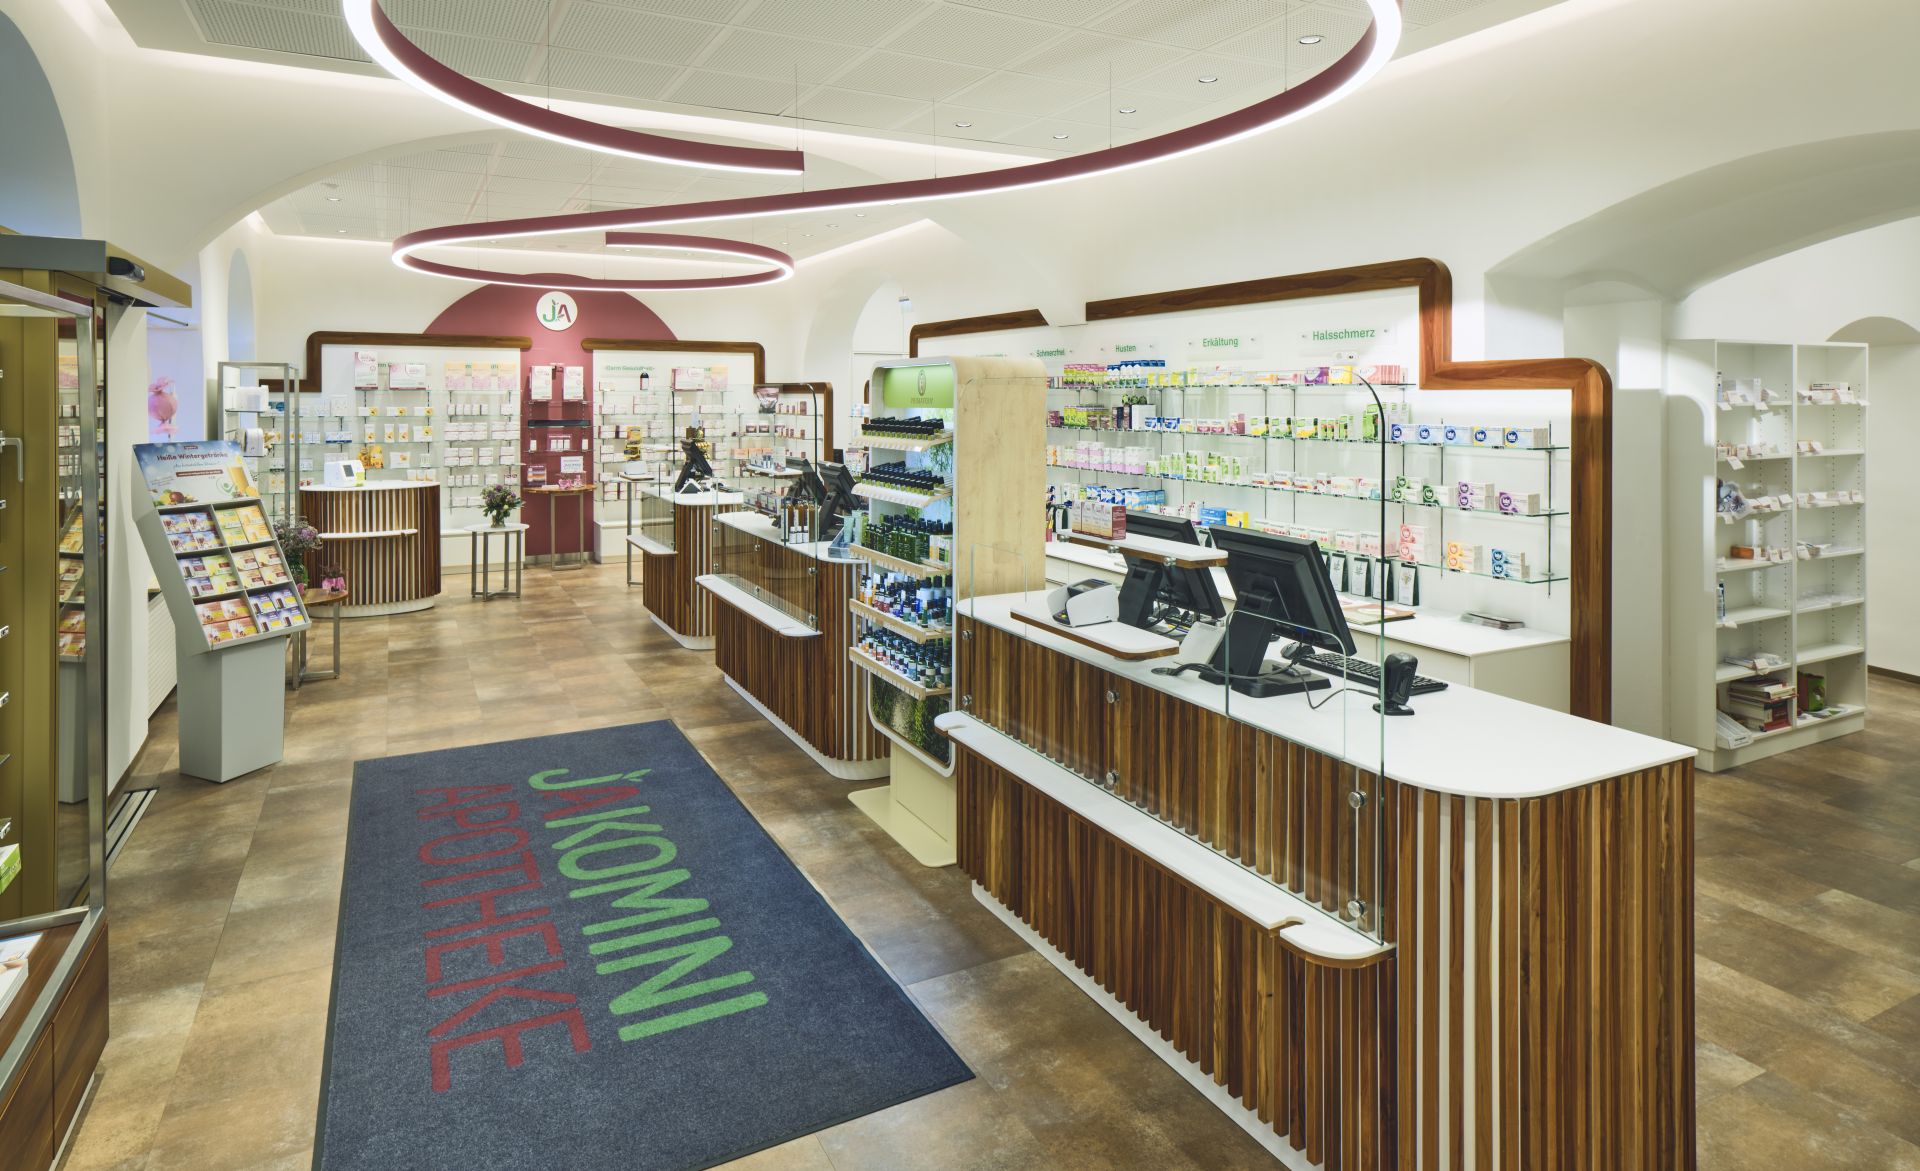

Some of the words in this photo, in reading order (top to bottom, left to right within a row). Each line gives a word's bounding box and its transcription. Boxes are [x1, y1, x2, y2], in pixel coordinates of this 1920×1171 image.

[543, 300, 571, 323] JA
[1202, 337, 1239, 348] Erkältung
[1312, 329, 1375, 341] Halsschmerz
[1115, 344, 1136, 353] Husten
[528, 768, 769, 1042] JAKOMINI
[415, 783, 593, 1094] APOTHEKE
